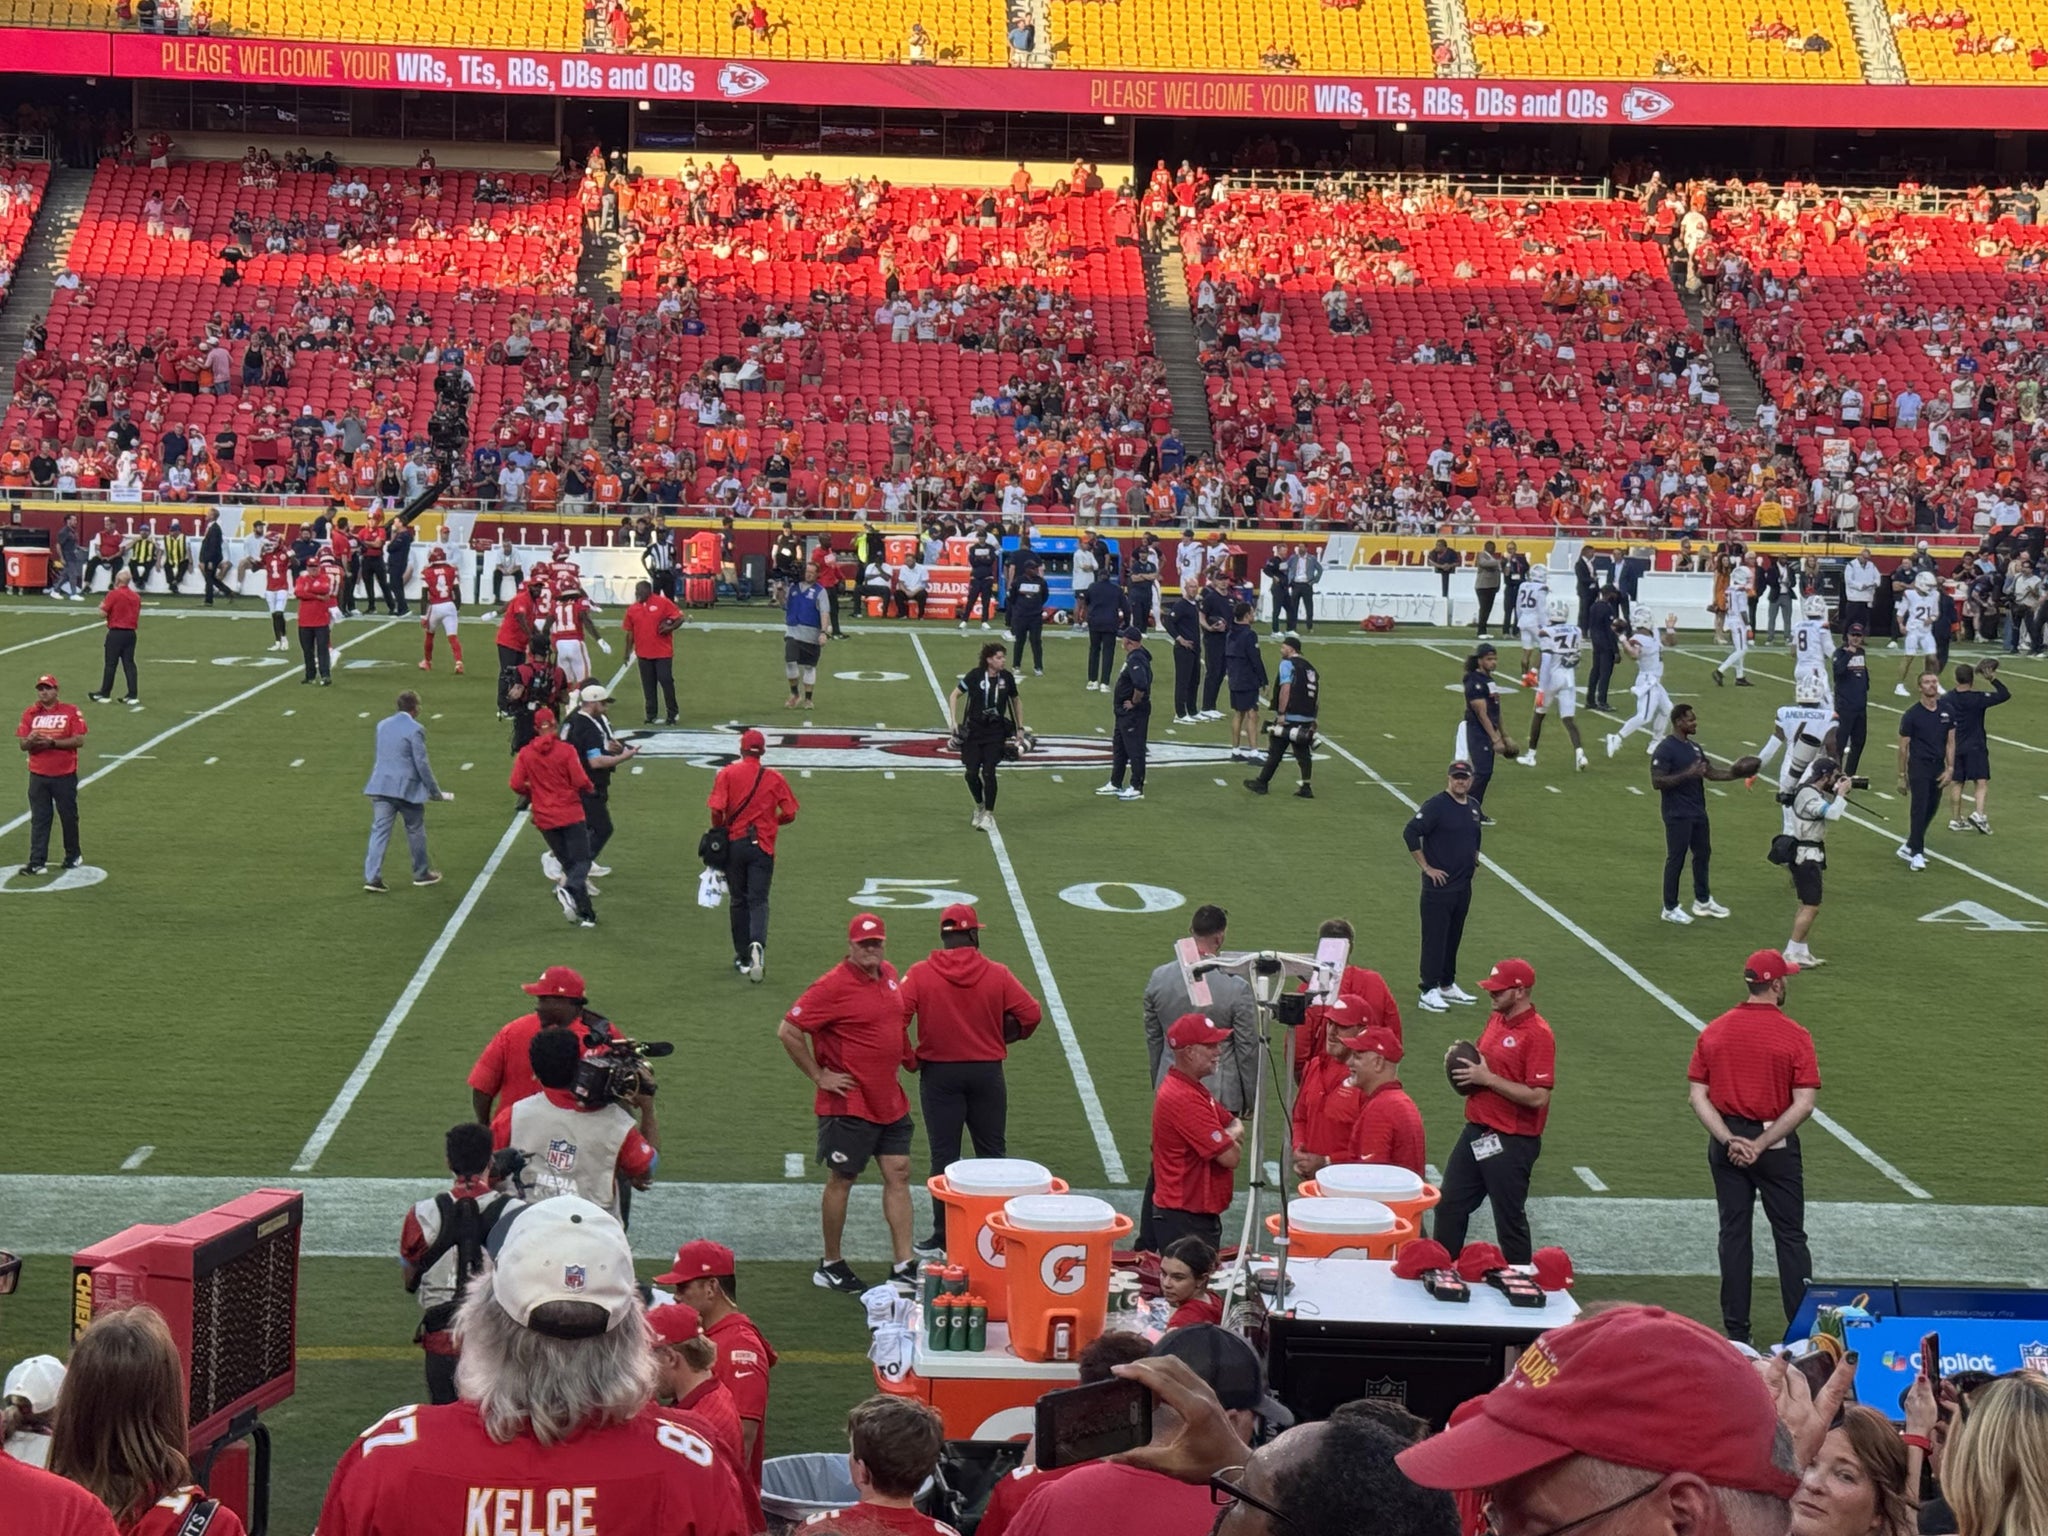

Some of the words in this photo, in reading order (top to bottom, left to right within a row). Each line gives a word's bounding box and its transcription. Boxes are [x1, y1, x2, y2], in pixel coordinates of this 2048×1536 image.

[161, 42, 232, 74] PLEASE
[238, 45, 333, 78] WELCOME
[340, 49, 391, 81] YOUR
[395, 52, 452, 87] WRs,
[458, 56, 502, 89] TEs,
[508, 57, 555, 91] RBs,
[561, 58, 603, 88] DBs
[608, 62, 648, 90] and
[653, 63, 695, 93] QBs
[1091, 79, 1157, 109] PLEASE
[1163, 81, 1254, 111] WELCOME
[1260, 83, 1309, 112] YOUR
[1314, 84, 1369, 118] WRs,
[1375, 86, 1417, 119] TEs,
[1422, 86, 1469, 120] RBs,
[1475, 87, 1517, 116] DBs
[1522, 89, 1561, 118] and
[1566, 89, 1608, 119] QBs
[361, 467, 374, 480] 10
[538, 479, 548, 493] 7
[7, 557, 20, 577] G
[271, 560, 280, 579] 1
[1520, 589, 1537, 608] 26
[555, 604, 577, 632] 11
[1798, 629, 1808, 652] 8
[31, 714, 69, 729] CHIEFS
[847, 877, 979, 909] 5
[1058, 881, 1187, 914] 0
[548, 1149, 572, 1170] NFL
[536, 1173, 578, 1191] MEDIA
[1040, 1243, 1088, 1295] G
[1909, 1353, 1997, 1376] Cpilot
[464, 1486, 598, 1536] KELCE
